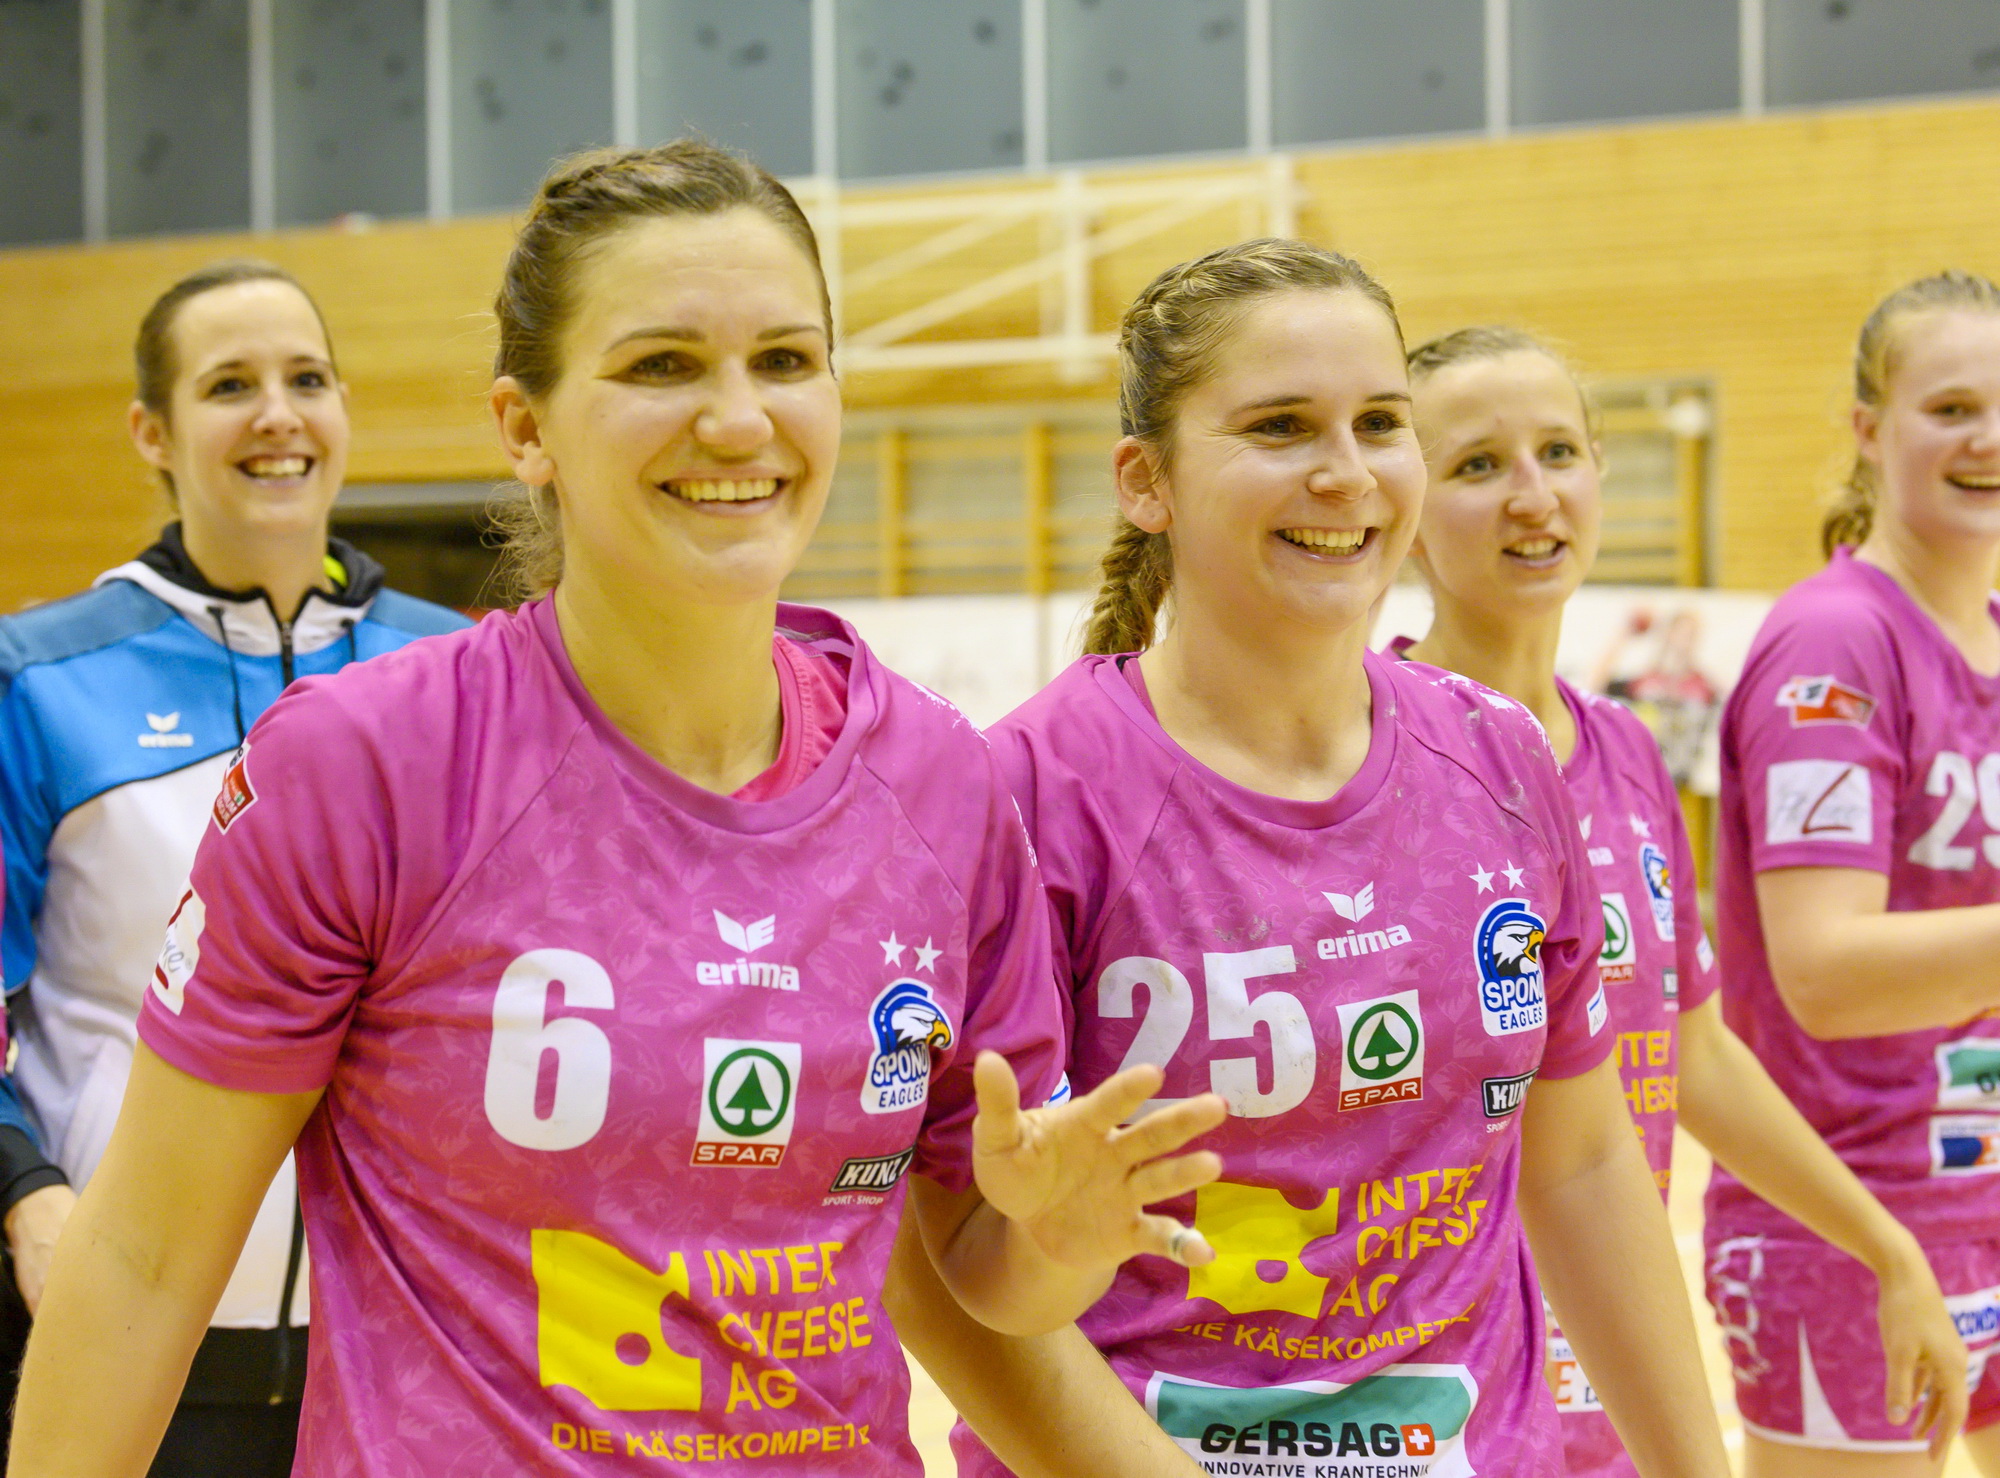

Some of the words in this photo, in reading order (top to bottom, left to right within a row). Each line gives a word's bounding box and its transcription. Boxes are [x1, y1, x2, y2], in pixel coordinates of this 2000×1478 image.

[1317, 924, 1412, 960] erima
[696, 958, 800, 991] erima
[1098, 945, 1316, 1122] 25
[1500, 1007, 1543, 1030] EAGLES
[484, 948, 615, 1151] 6
[879, 1083, 923, 1107] EAGLES
[1343, 1080, 1419, 1109] SPAR
[697, 1144, 780, 1164] SPAR
[703, 1241, 843, 1297] INTER
[717, 1296, 872, 1359] CHEESE
[725, 1362, 798, 1414] AG
[552, 1423, 614, 1453] DIE
[1200, 1420, 1400, 1458] GERSAG
